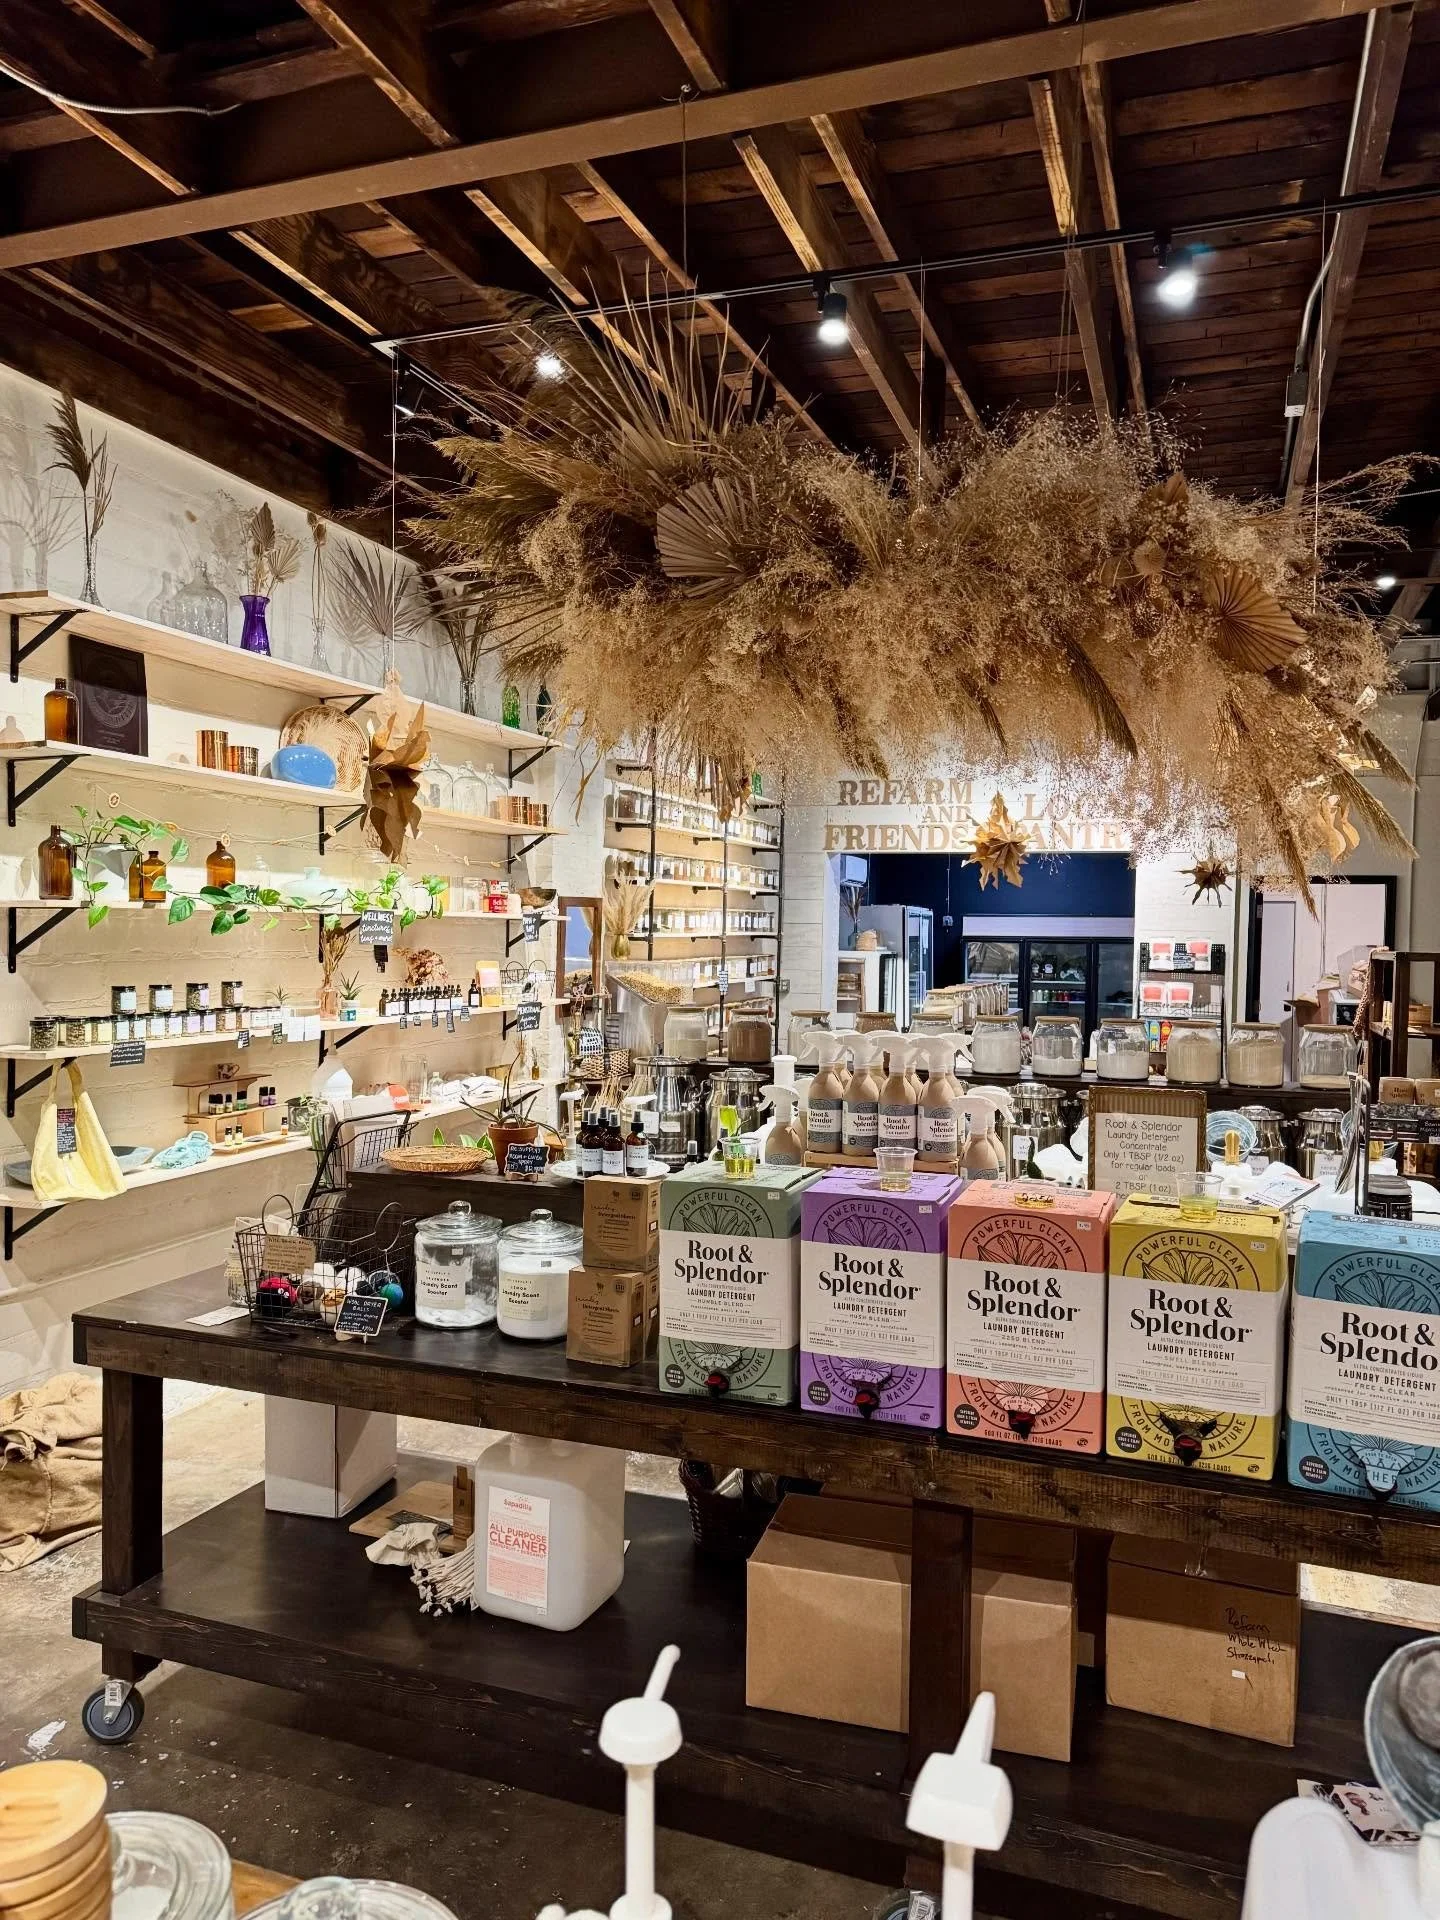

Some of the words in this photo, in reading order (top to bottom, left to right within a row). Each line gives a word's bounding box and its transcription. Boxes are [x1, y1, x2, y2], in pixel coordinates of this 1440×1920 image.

[838, 778, 972, 806] REFARM
[922, 805, 972, 823] AND
[823, 824, 969, 851] FRIENDS
[361, 911, 394, 923] WELLNESS
[1105, 1119, 1127, 1129] Root
[1131, 1120, 1137, 1129] &
[1140, 1121, 1182, 1132] Splendor
[1107, 1130, 1138, 1141] Laundry
[1141, 1132, 1179, 1143] Detergent
[1103, 1151, 1119, 1160] Only
[1129, 1152, 1151, 1160] TBSP
[1171, 1154, 1184, 1164] oz)
[1119, 1141, 1167, 1151] Concentrate
[1126, 1163, 1153, 1171] regular
[1155, 1163, 1176, 1172] loads
[1124, 1181, 1146, 1190] TBSP
[1158, 1184, 1171, 1194] oz)
[679, 1192, 728, 1216] POWERFUL
[734, 1195, 763, 1223] CLEAN
[823, 1203, 877, 1227] POWERFUL
[882, 1207, 914, 1236] CLEAN
[972, 1218, 1032, 1244] POWERFUL
[1039, 1223, 1073, 1255] CLEAN
[688, 1240, 735, 1262] Root
[738, 1244, 754, 1263] &
[834, 1252, 885, 1276] Root
[888, 1258, 904, 1278] &
[1136, 1235, 1202, 1262] POWERFUL
[1208, 1240, 1245, 1273] CLEAN
[674, 1258, 767, 1284] Splendor
[984, 1269, 1040, 1296] Root
[1044, 1277, 1062, 1298] &
[1329, 1256, 1402, 1283] POWERFUL
[1410, 1263, 1440, 1294] CLEA
[687, 1288, 716, 1298] LAUNDRY
[718, 1290, 756, 1301] DETERGENT
[818, 1270, 919, 1300] Splendor
[833, 1301, 864, 1312] LAUNDRY
[867, 1306, 907, 1317] DETERGENT
[967, 1289, 1078, 1321] Splendor
[1148, 1288, 1210, 1316] Root
[1213, 1296, 1233, 1319] &
[983, 1322, 1018, 1334] LAUNDRY
[1021, 1326, 1065, 1340] DETERGENT
[1130, 1308, 1249, 1343] Splendor
[1341, 1311, 1409, 1343] Root
[1414, 1323, 1436, 1347] &
[1022, 1337, 1046, 1345] BLEND
[1147, 1342, 1184, 1355] LAUNDRY
[1188, 1347, 1235, 1361] DETERGENT
[1320, 1332, 1440, 1371] Splendo
[674, 1343, 692, 1370] FROM
[735, 1352, 766, 1384] NATURE
[818, 1359, 837, 1387] FROM
[887, 1370, 918, 1402] NATURE
[1338, 1368, 1380, 1382] LAUNDRY
[1384, 1375, 1437, 1392] DETERGENT
[967, 1382, 988, 1411] FROM
[1354, 1382, 1376, 1390] FREE
[1387, 1388, 1416, 1397] CLEAR
[1041, 1394, 1076, 1427] NATURE
[1130, 1403, 1152, 1434] FROM
[1045, 1437, 1063, 1447] LOADS
[1208, 1419, 1247, 1452] NATURE
[1316, 1432, 1341, 1464] FROM
[489, 1523, 505, 1534] ALL
[507, 1527, 547, 1543] PURPOSE
[489, 1531, 547, 1555] CLEANER
[1228, 1632, 1256, 1649] Whole
